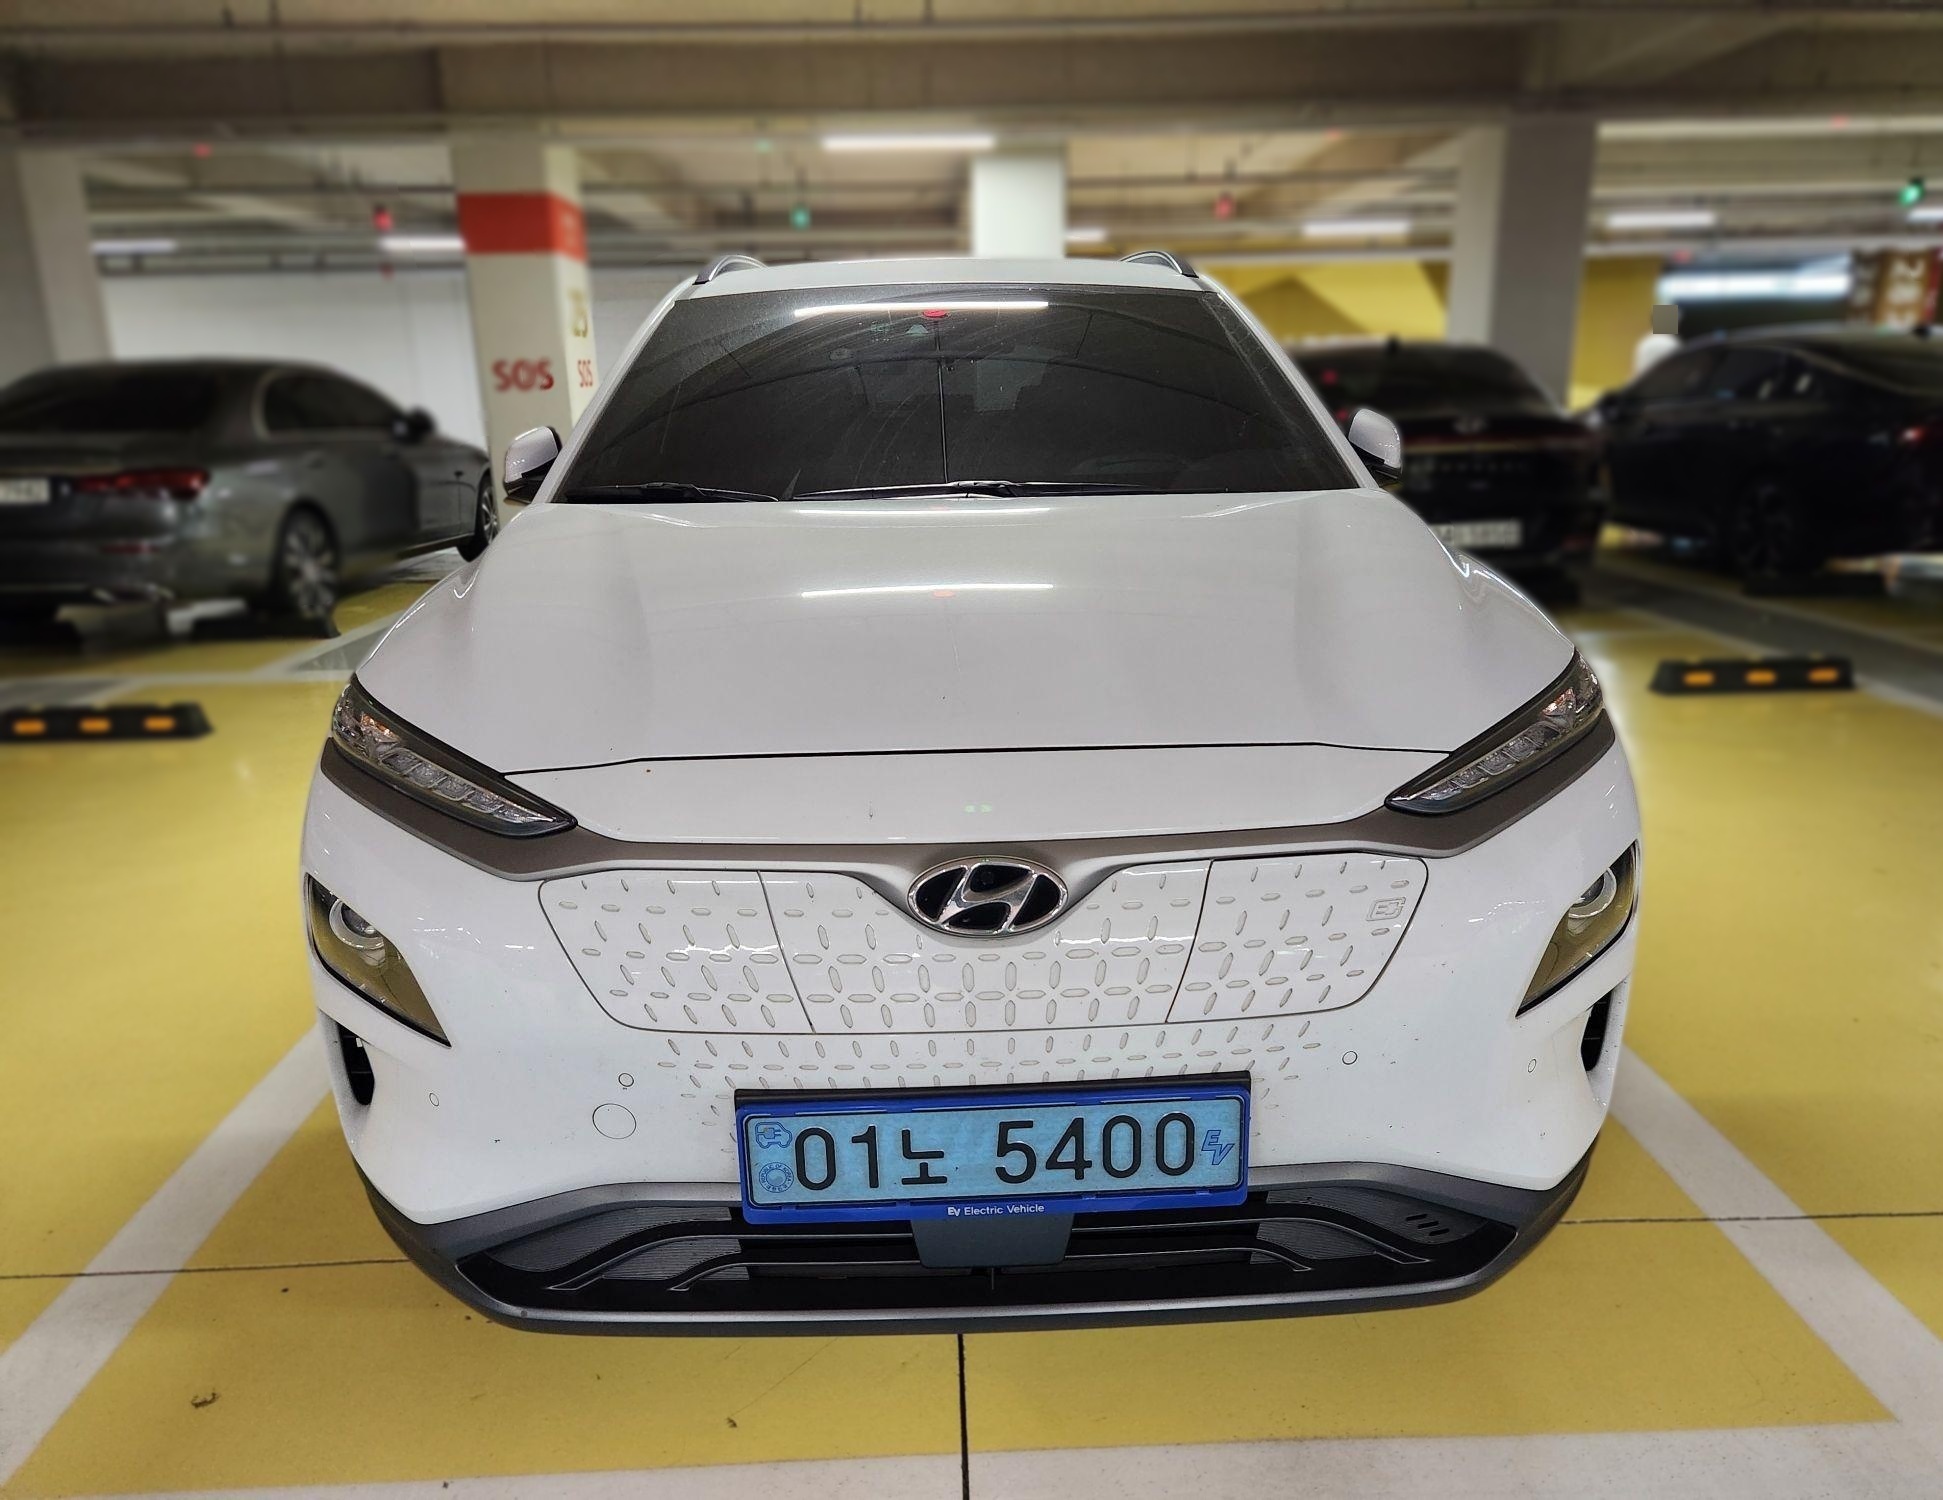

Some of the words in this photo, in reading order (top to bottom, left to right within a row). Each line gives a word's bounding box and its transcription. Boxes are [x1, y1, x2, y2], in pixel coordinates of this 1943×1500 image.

[491, 359, 554, 393] SOS
[577, 359, 594, 389] SOS
[794, 1123, 948, 1191] 01노
[994, 1112, 1196, 1185] 5400
[1201, 1129, 1235, 1166] EV
[964, 1205, 1004, 1216] Electric
[1007, 1204, 1045, 1214] Vehicle
